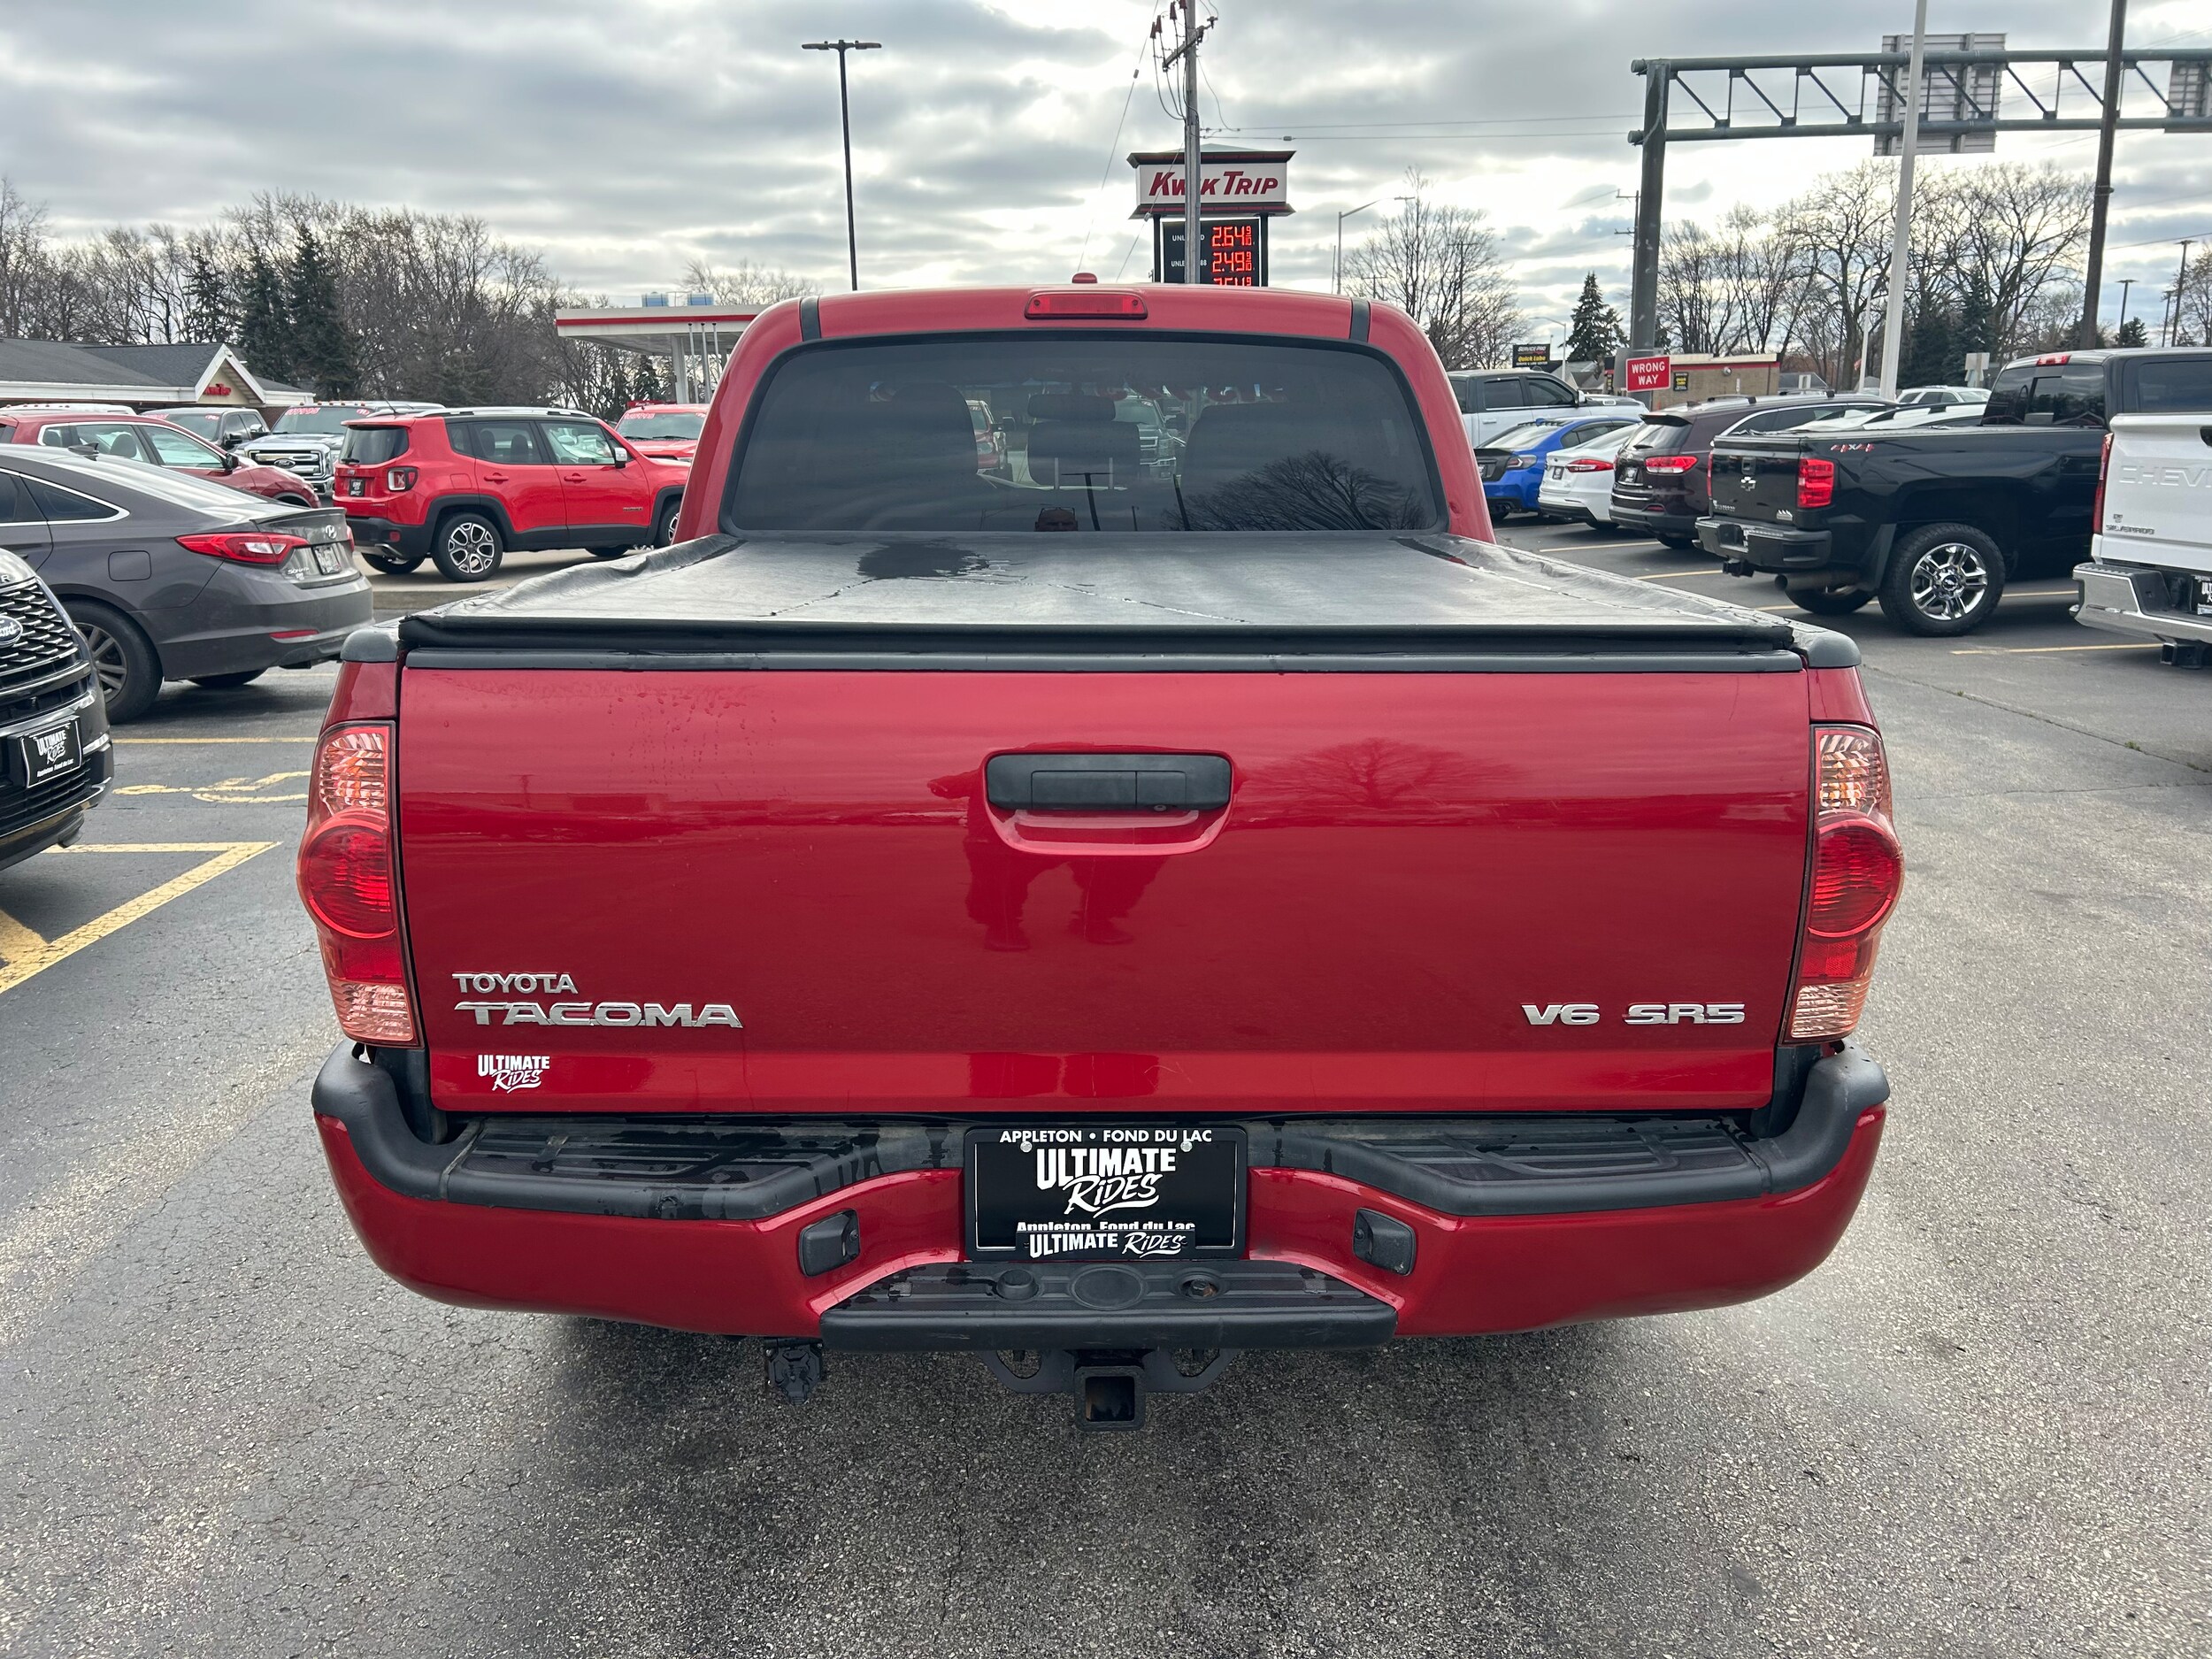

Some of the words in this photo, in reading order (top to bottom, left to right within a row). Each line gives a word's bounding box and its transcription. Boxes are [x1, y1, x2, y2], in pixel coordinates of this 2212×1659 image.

[1149, 172, 1220, 196] KWK
[1223, 172, 1279, 195] TRIP
[1212, 226, 1245, 246] 2.64
[1212, 251, 1245, 272] 2.49
[1632, 361, 1665, 373] WRONG
[1638, 374, 1658, 386] WAY
[0, 621, 19, 637] ord
[452, 972, 578, 994] TOYOTA
[454, 1002, 743, 1028] TACOMA
[1522, 1003, 1601, 1025] V6
[1624, 1003, 1746, 1024] SR5
[478, 1055, 550, 1077] ULTIMATE
[1000, 1130, 1081, 1142] APPLETON
[1103, 1130, 1149, 1141] FOND
[1155, 1130, 1177, 1141] DU
[1183, 1130, 1211, 1141] LAC
[1036, 1148, 1176, 1190] ULTIMATE
[1029, 1233, 1118, 1258] ULTIMATE
